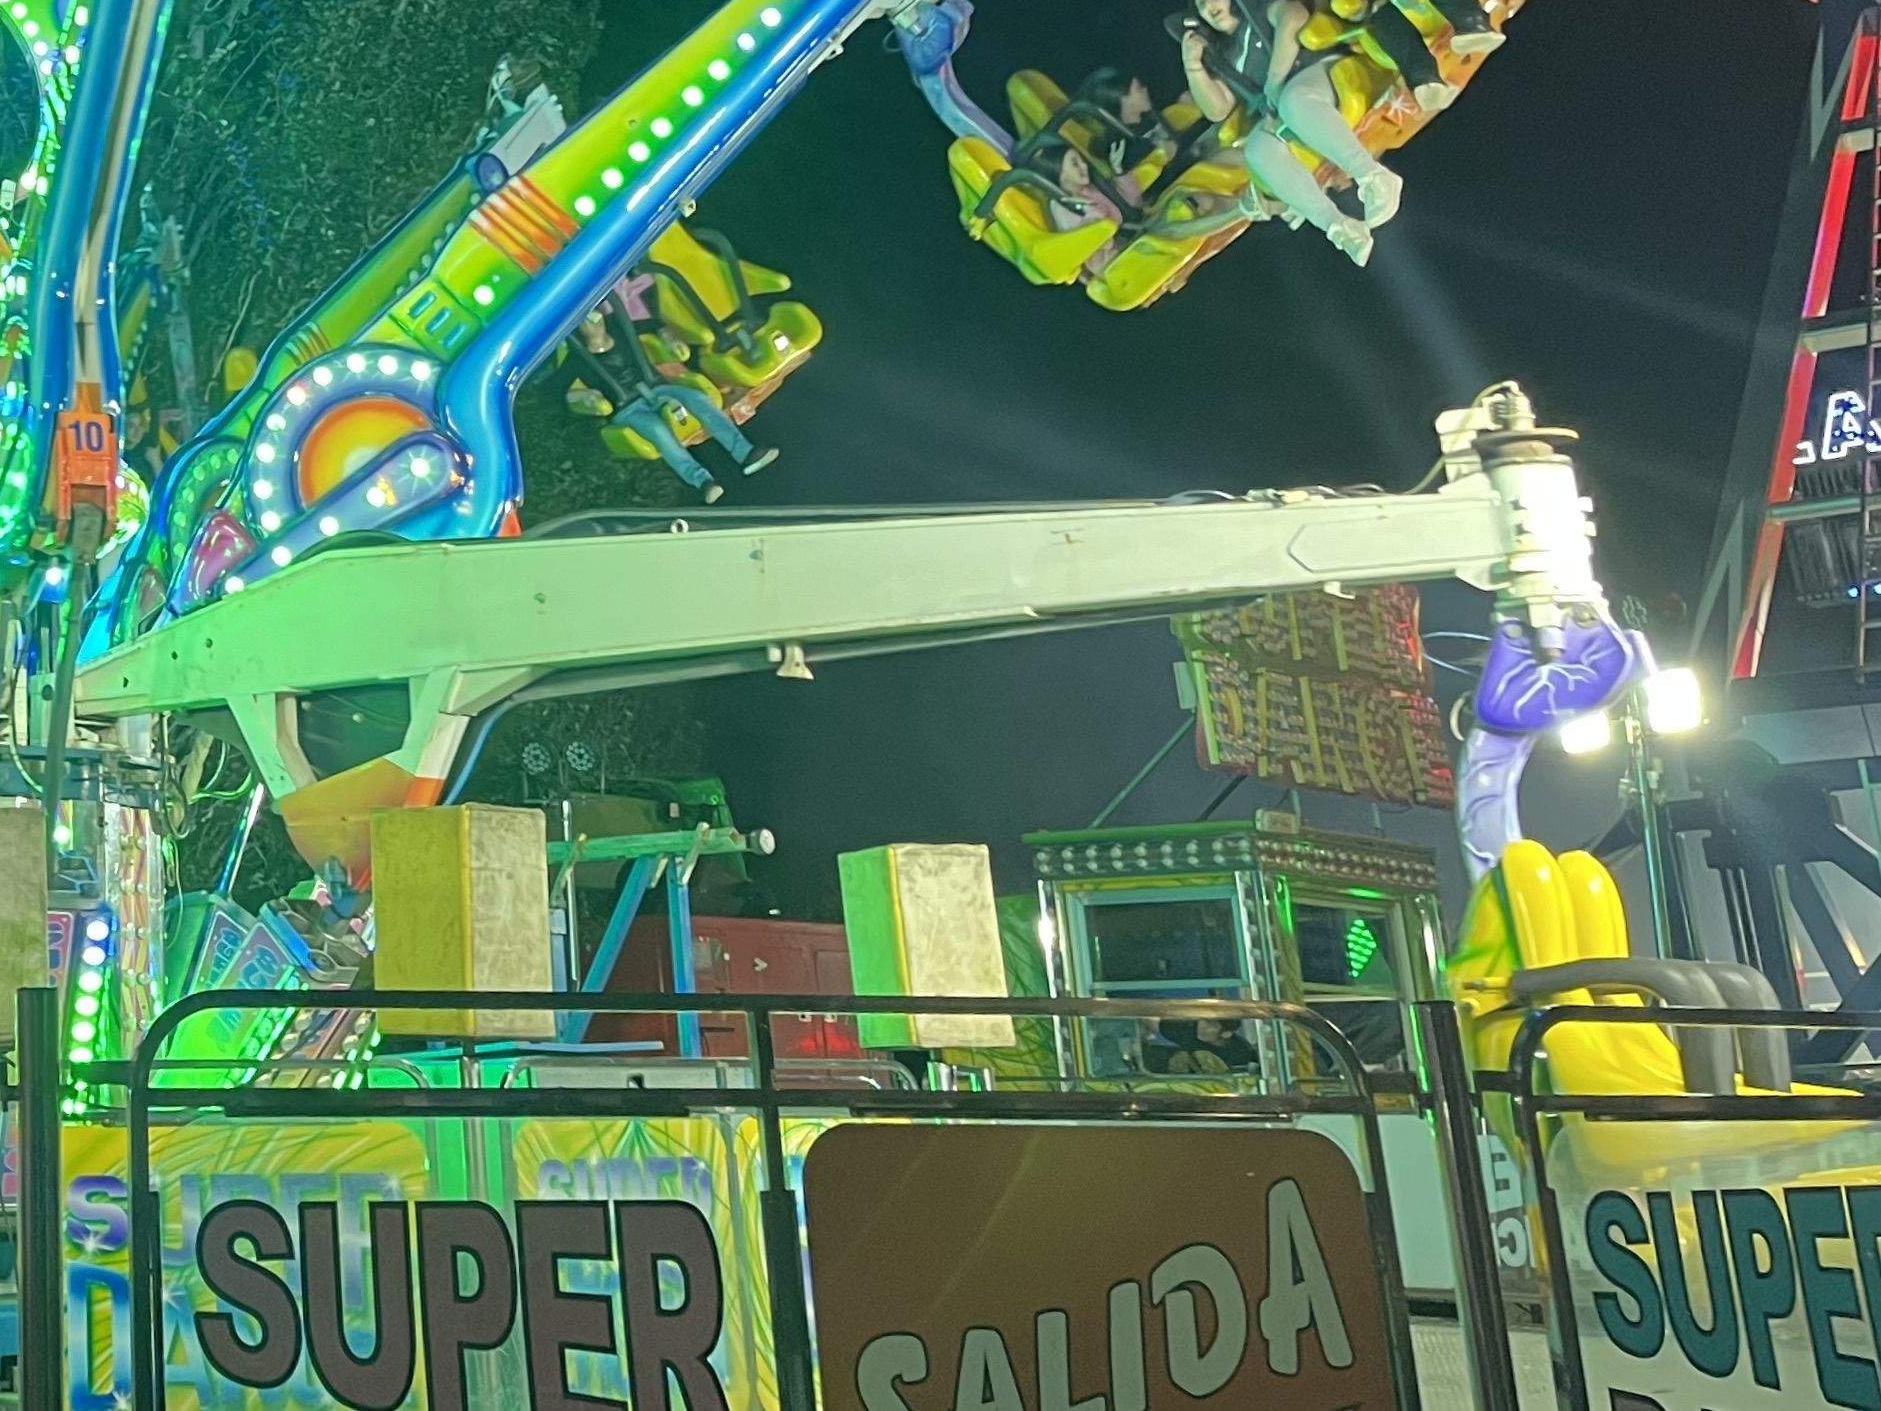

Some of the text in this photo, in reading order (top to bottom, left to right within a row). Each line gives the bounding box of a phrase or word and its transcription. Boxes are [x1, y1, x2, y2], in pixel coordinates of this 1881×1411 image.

[68, 420, 105, 452] 10
[194, 1198, 730, 1411] SUPER
[855, 1177, 1356, 1411] SALIDA
